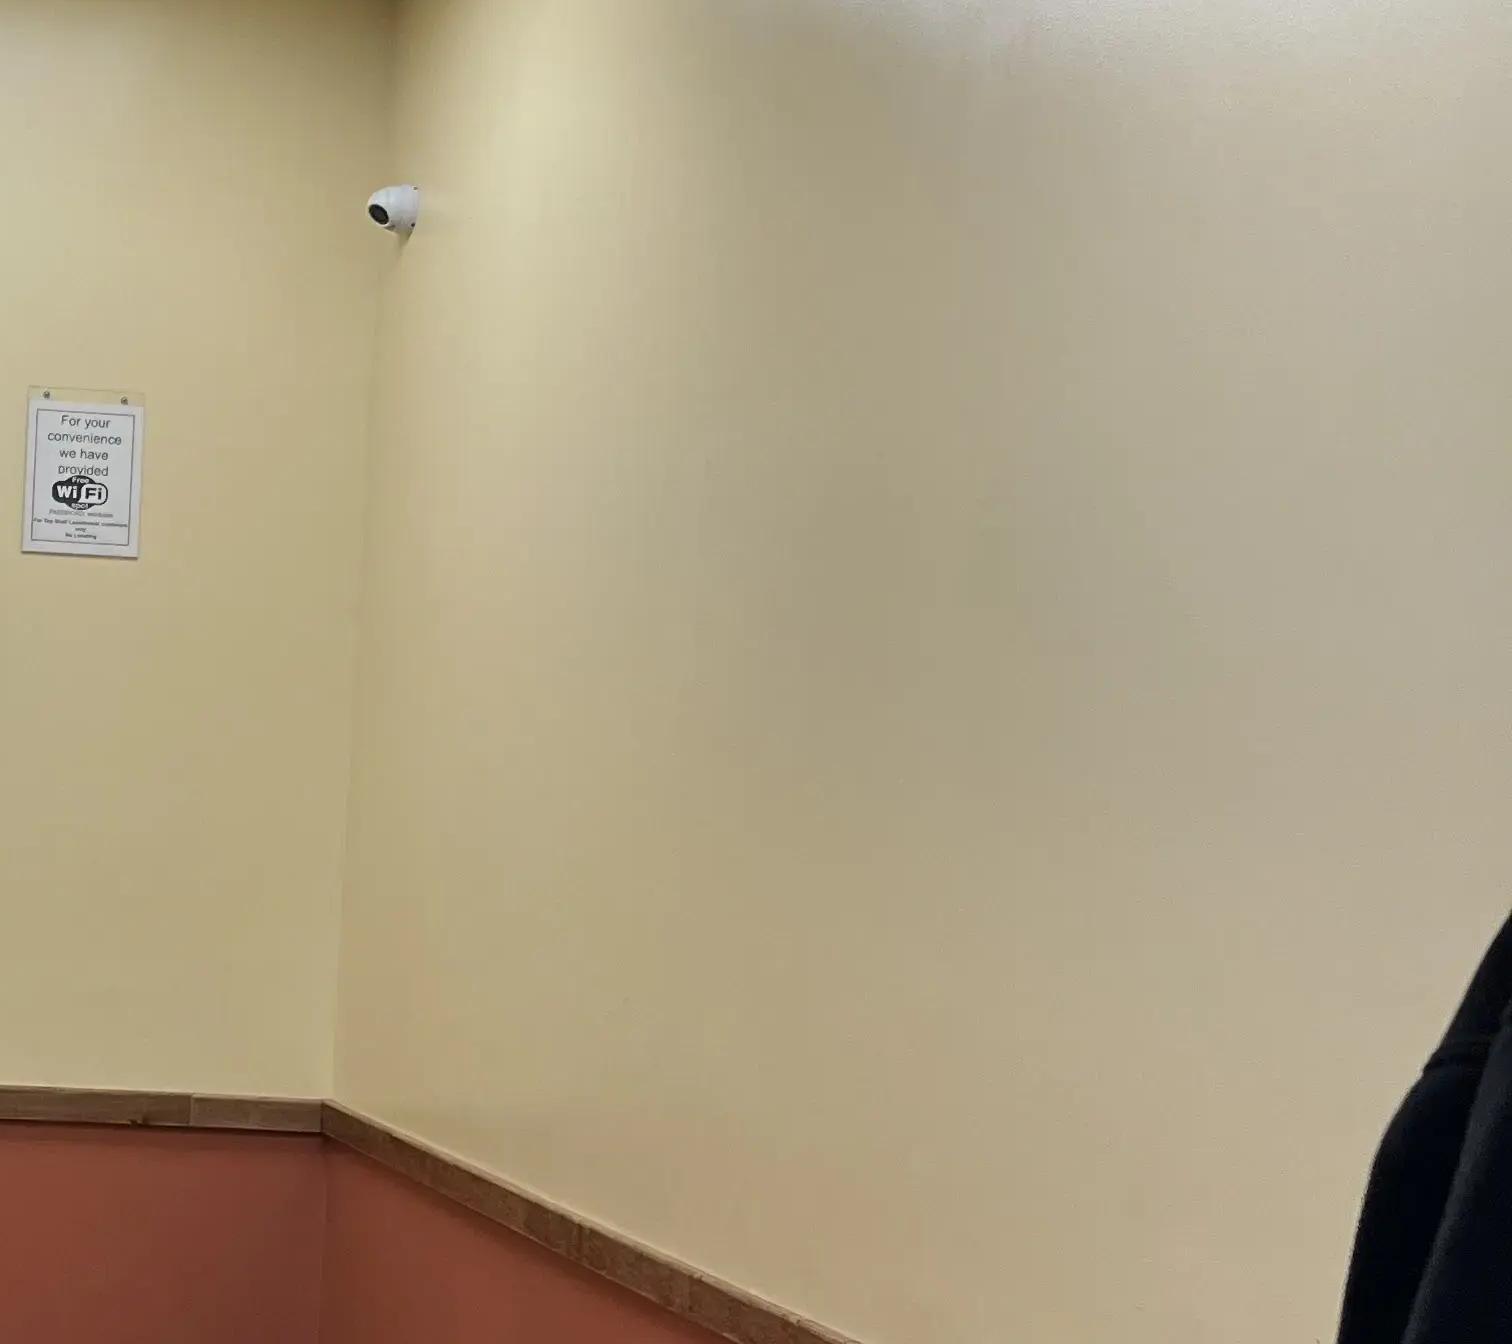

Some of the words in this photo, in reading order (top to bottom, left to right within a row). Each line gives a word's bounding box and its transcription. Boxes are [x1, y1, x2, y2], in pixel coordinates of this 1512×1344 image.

[61, 415, 82, 428] For
[84, 418, 111, 430] your
[47, 432, 122, 445] convenience
[59, 449, 77, 460] we
[79, 448, 109, 461] have
[57, 464, 109, 477] provided
